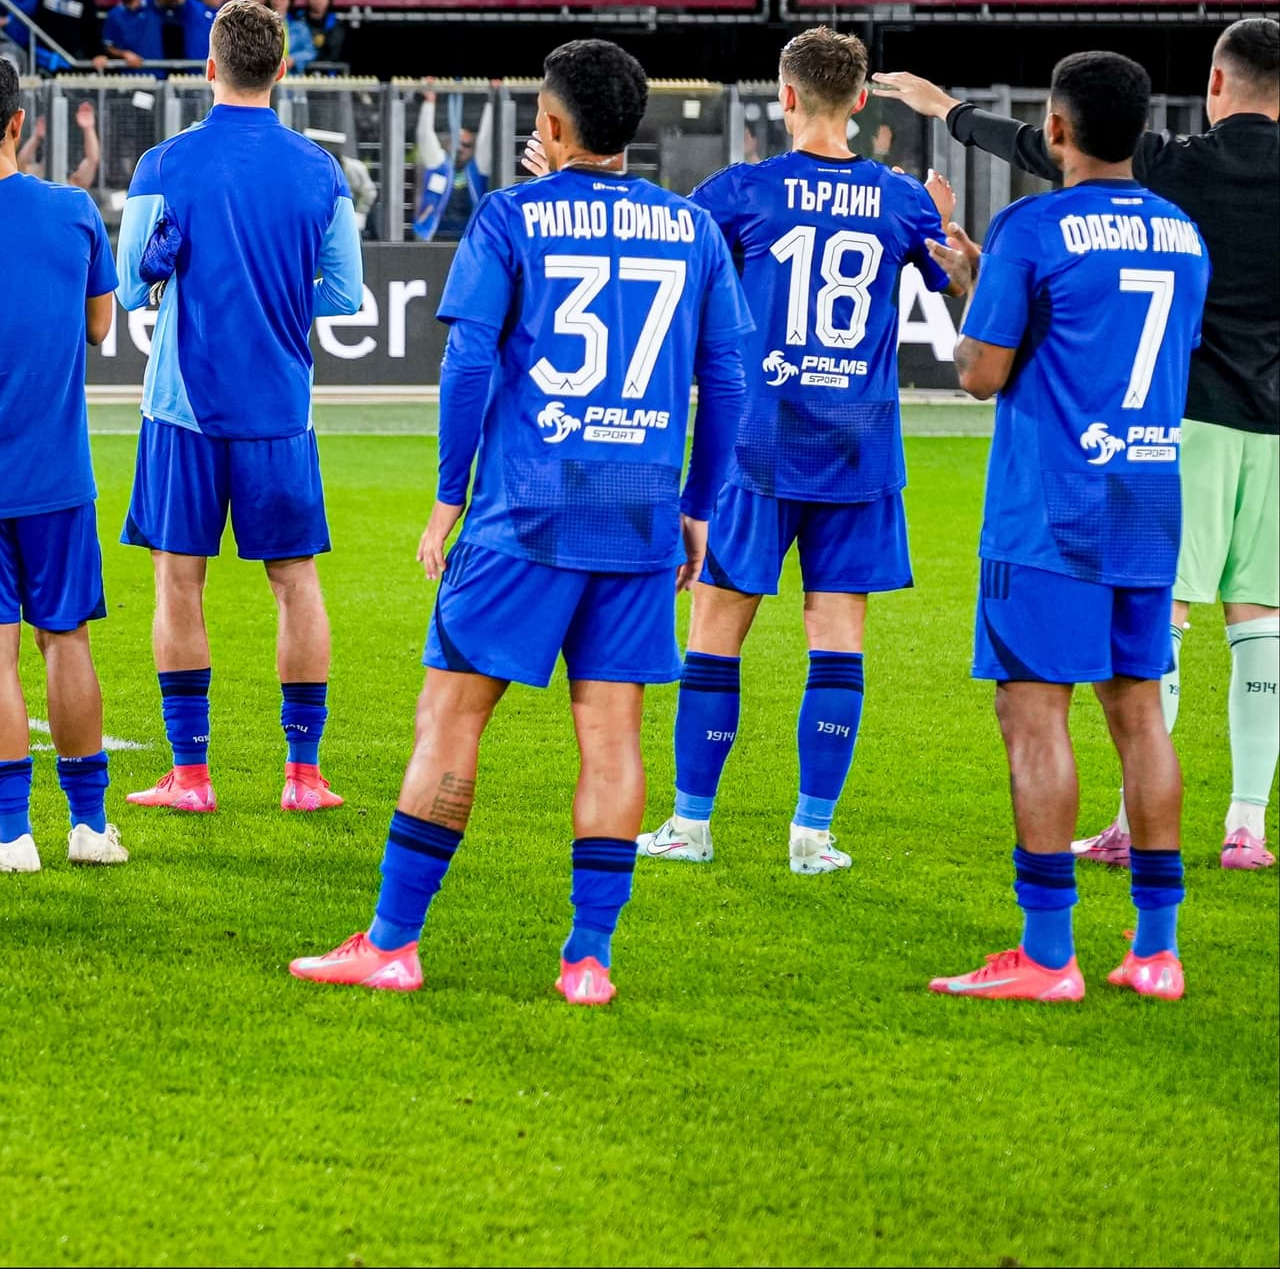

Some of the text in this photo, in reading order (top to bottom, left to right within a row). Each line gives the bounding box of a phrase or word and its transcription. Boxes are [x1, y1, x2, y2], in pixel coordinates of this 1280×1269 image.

[783, 178, 882, 218] ТЪРДИН
[521, 198, 696, 243] РИЛДО ФИЛЬО
[1059, 214, 1149, 255] ФАБИО
[768, 225, 885, 350] 18
[528, 254, 687, 399] 37
[1119, 268, 1176, 409] 7
[801, 355, 868, 376] PALMS
[807, 375, 844, 384] SPORT
[584, 406, 670, 429] PALMS
[592, 429, 637, 441] SPORT
[1127, 426, 1182, 444] PALM
[1135, 449, 1172, 458] SPORT
[1244, 681, 1278, 694] 1914
[705, 729, 736, 742] 1914
[816, 720, 851, 738] 1914
